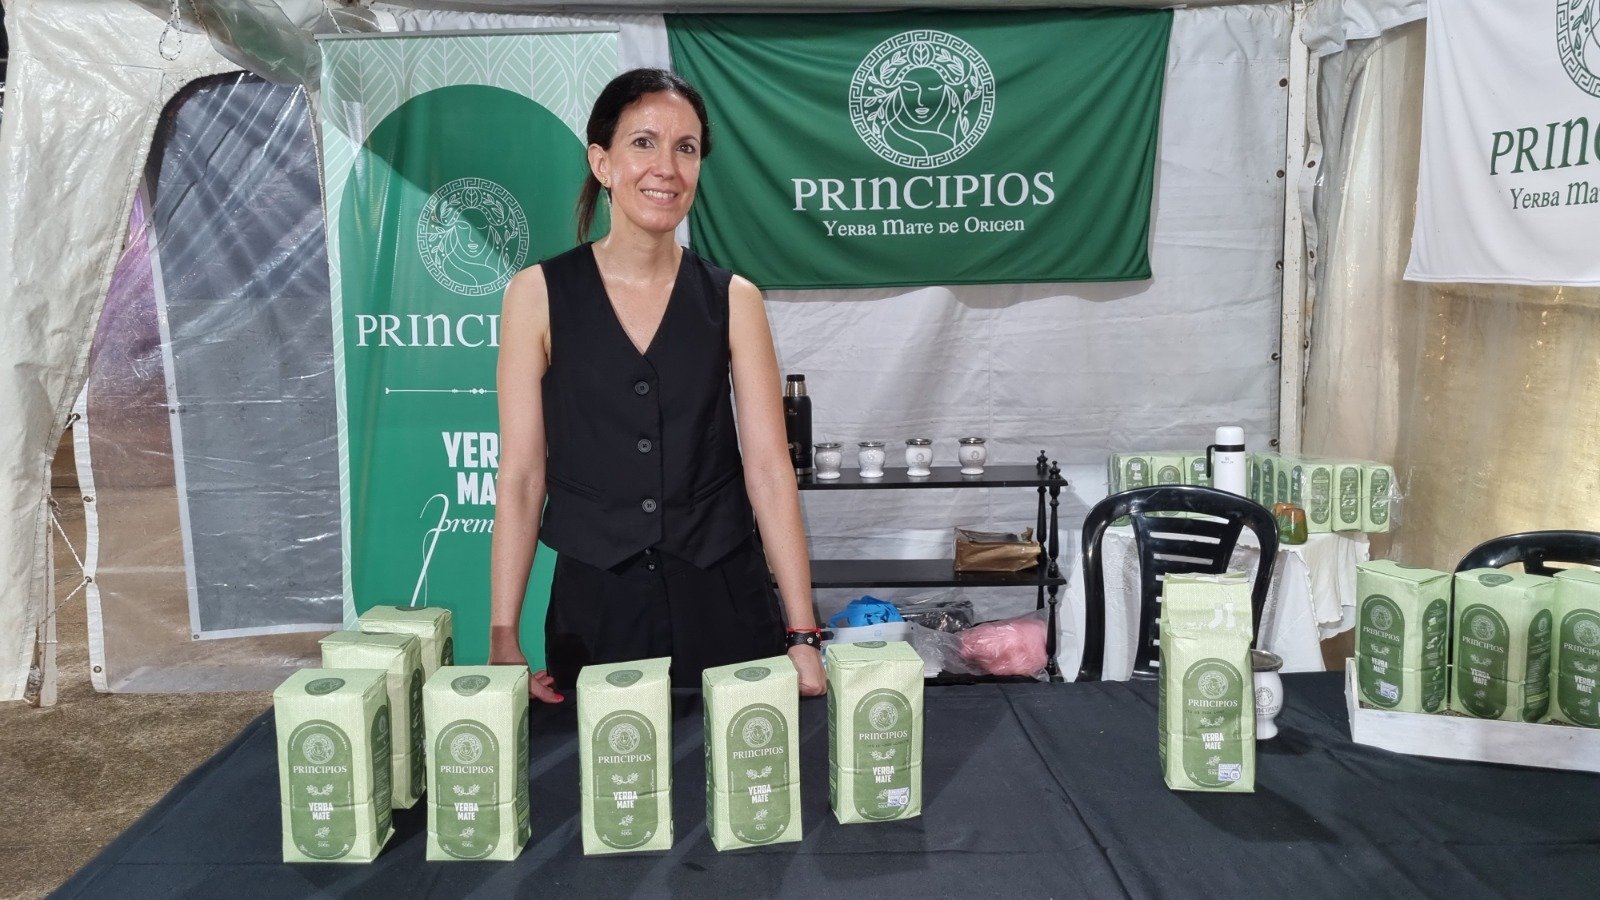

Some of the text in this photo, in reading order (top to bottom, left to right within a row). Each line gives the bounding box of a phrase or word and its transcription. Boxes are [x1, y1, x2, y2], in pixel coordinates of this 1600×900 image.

[1489, 115, 1600, 176] PRIN
[791, 171, 1056, 211] PRINCIPIOS
[456, 471, 499, 506] MA
[1188, 698, 1238, 708] PRINCIPIOS
[859, 730, 908, 740] PRINCIPIOS
[1201, 732, 1225, 742] YERBA
[1204, 742, 1222, 750] MATE
[732, 746, 784, 760] PRINCIPIOS
[598, 753, 652, 765] PRINCIPIOS
[293, 765, 347, 774] PRINCIPIOS
[440, 765, 494, 774] PRINCIPIOS
[872, 765, 895, 775] YERBA
[875, 775, 892, 784] MATE
[613, 790, 638, 800] YERBA
[748, 784, 772, 796] YERBA
[751, 794, 769, 804] MATE
[308, 802, 334, 812] YERBA
[454, 802, 479, 812] YERBA
[616, 800, 635, 809] MATE
[312, 812, 331, 820] MATE
[457, 812, 476, 820] MATE
